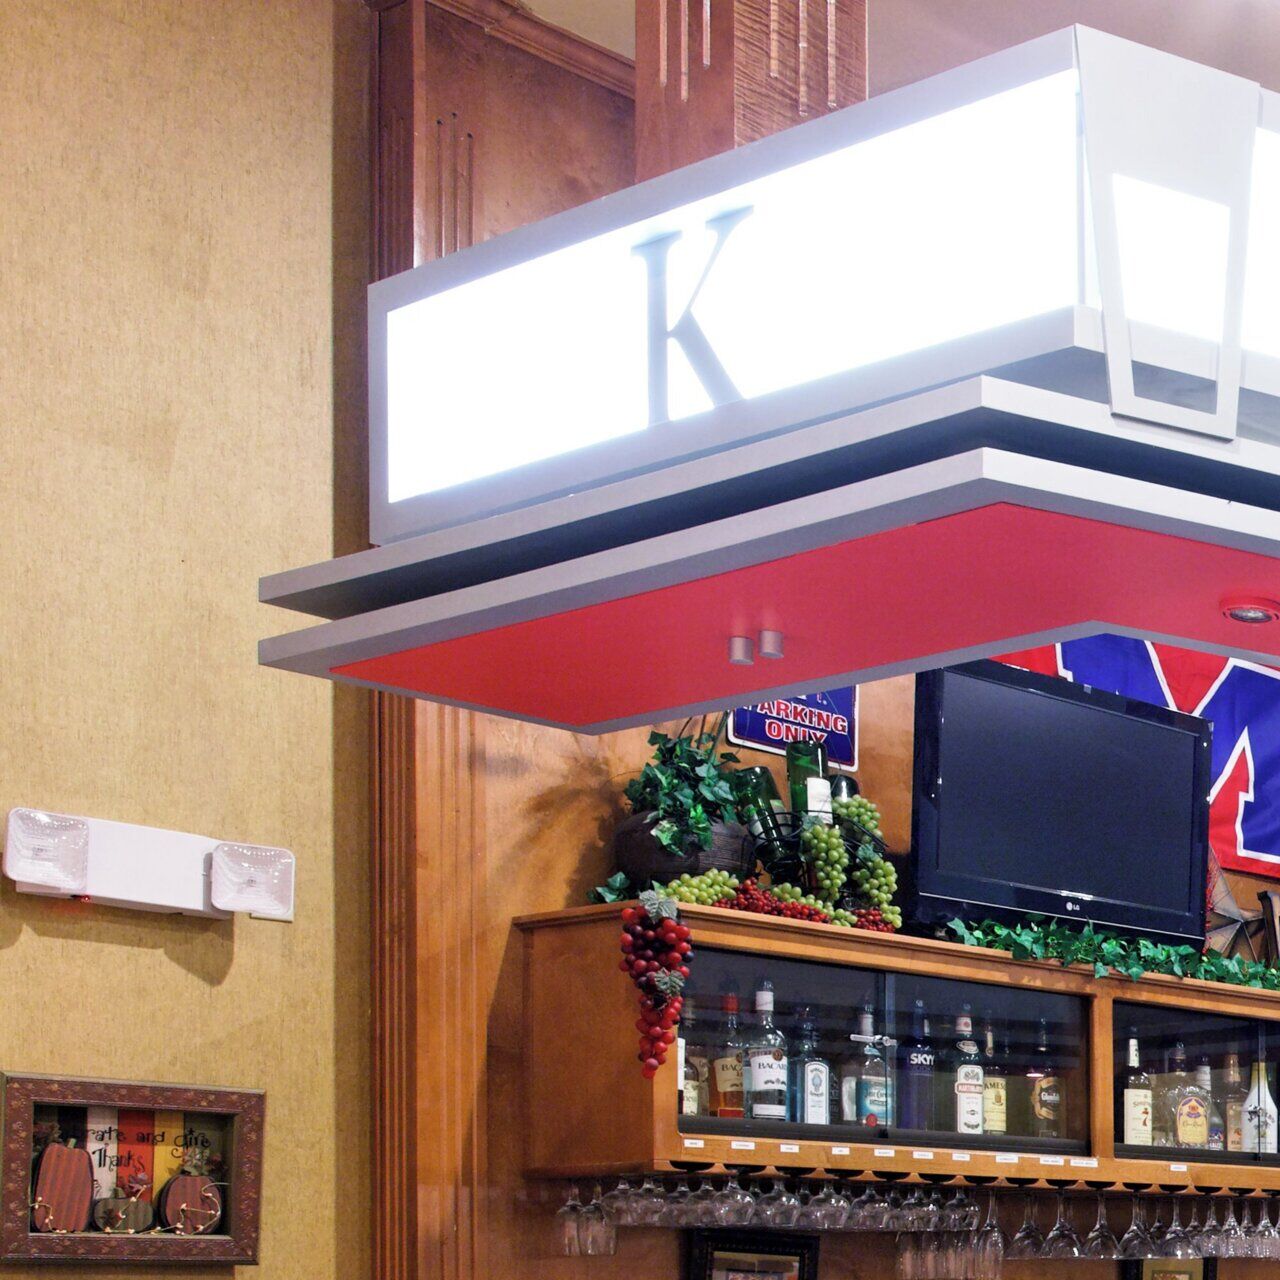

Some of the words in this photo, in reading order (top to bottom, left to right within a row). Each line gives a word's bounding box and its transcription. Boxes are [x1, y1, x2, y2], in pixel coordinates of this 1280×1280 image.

[632, 205, 753, 426] K
[744, 699, 848, 735] ARKING
[910, 1053, 934, 1065] SKYY
[984, 1081, 1006, 1091] AMES
[92, 1146, 146, 1172] Thanks
